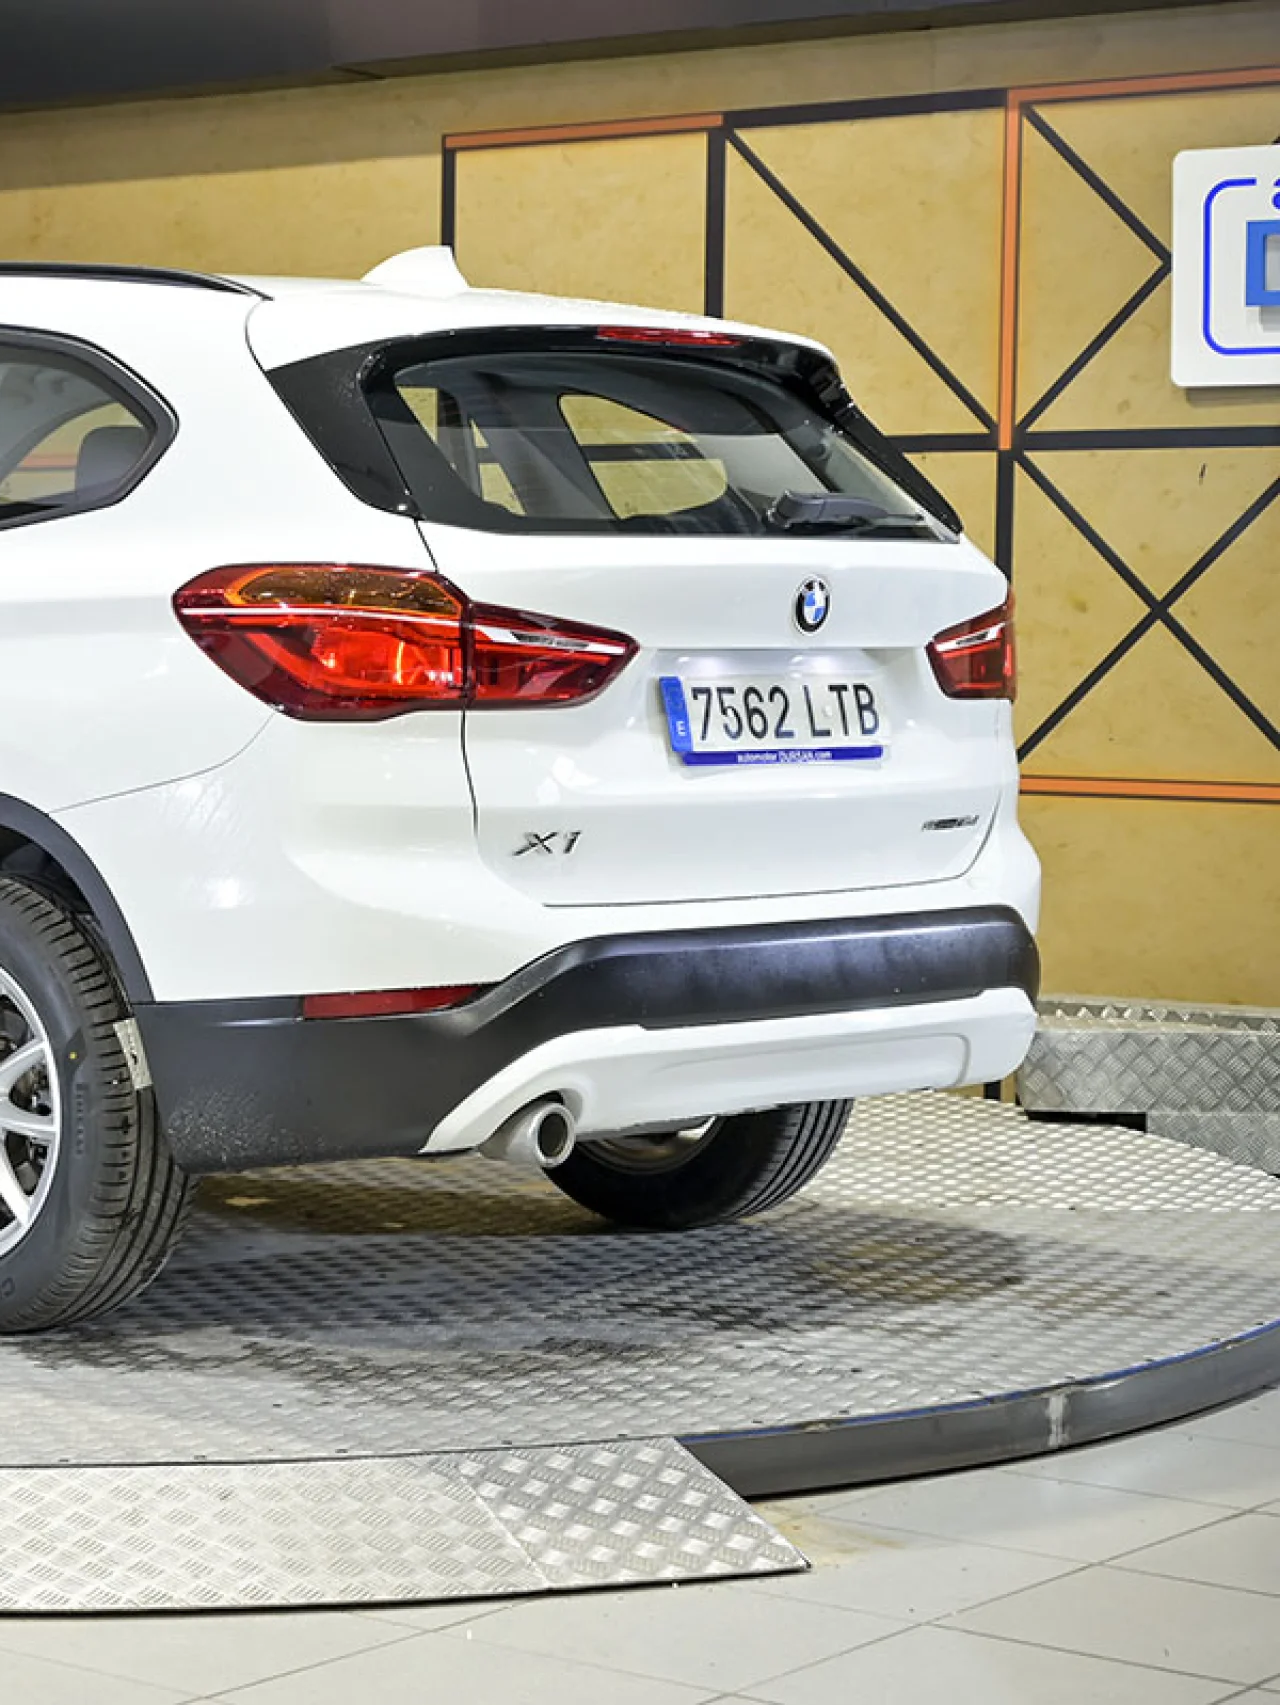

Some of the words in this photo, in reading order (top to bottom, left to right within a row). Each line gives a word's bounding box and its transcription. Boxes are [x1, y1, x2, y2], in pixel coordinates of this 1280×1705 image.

[690, 685, 795, 741] 7562
[803, 683, 880, 737] LTB
[675, 720, 687, 737] E
[511, 830, 583, 857] X1
